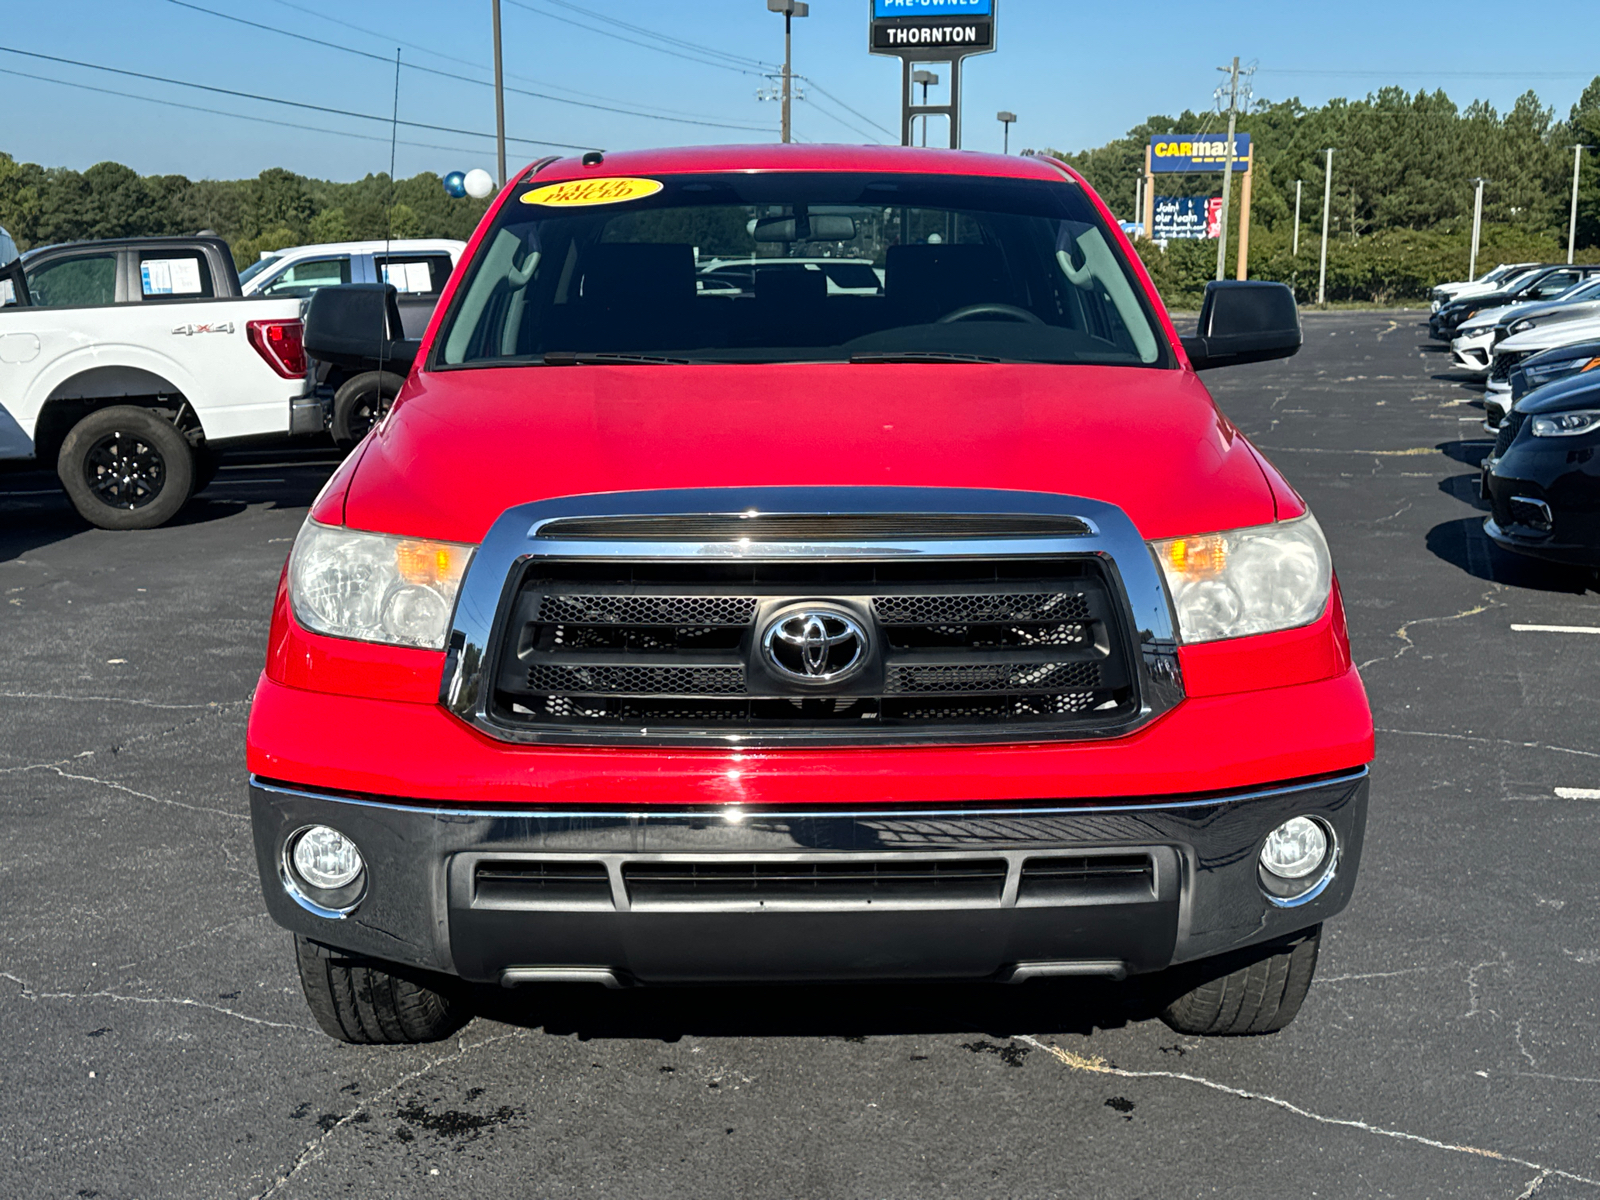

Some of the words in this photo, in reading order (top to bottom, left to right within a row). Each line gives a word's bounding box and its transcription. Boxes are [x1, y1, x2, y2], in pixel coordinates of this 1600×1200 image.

[887, 26, 976, 43] THORNTON
[557, 180, 634, 193] VALUE
[543, 187, 634, 202] PRICED
[1156, 202, 1176, 212] Join
[1155, 214, 1172, 222] our
